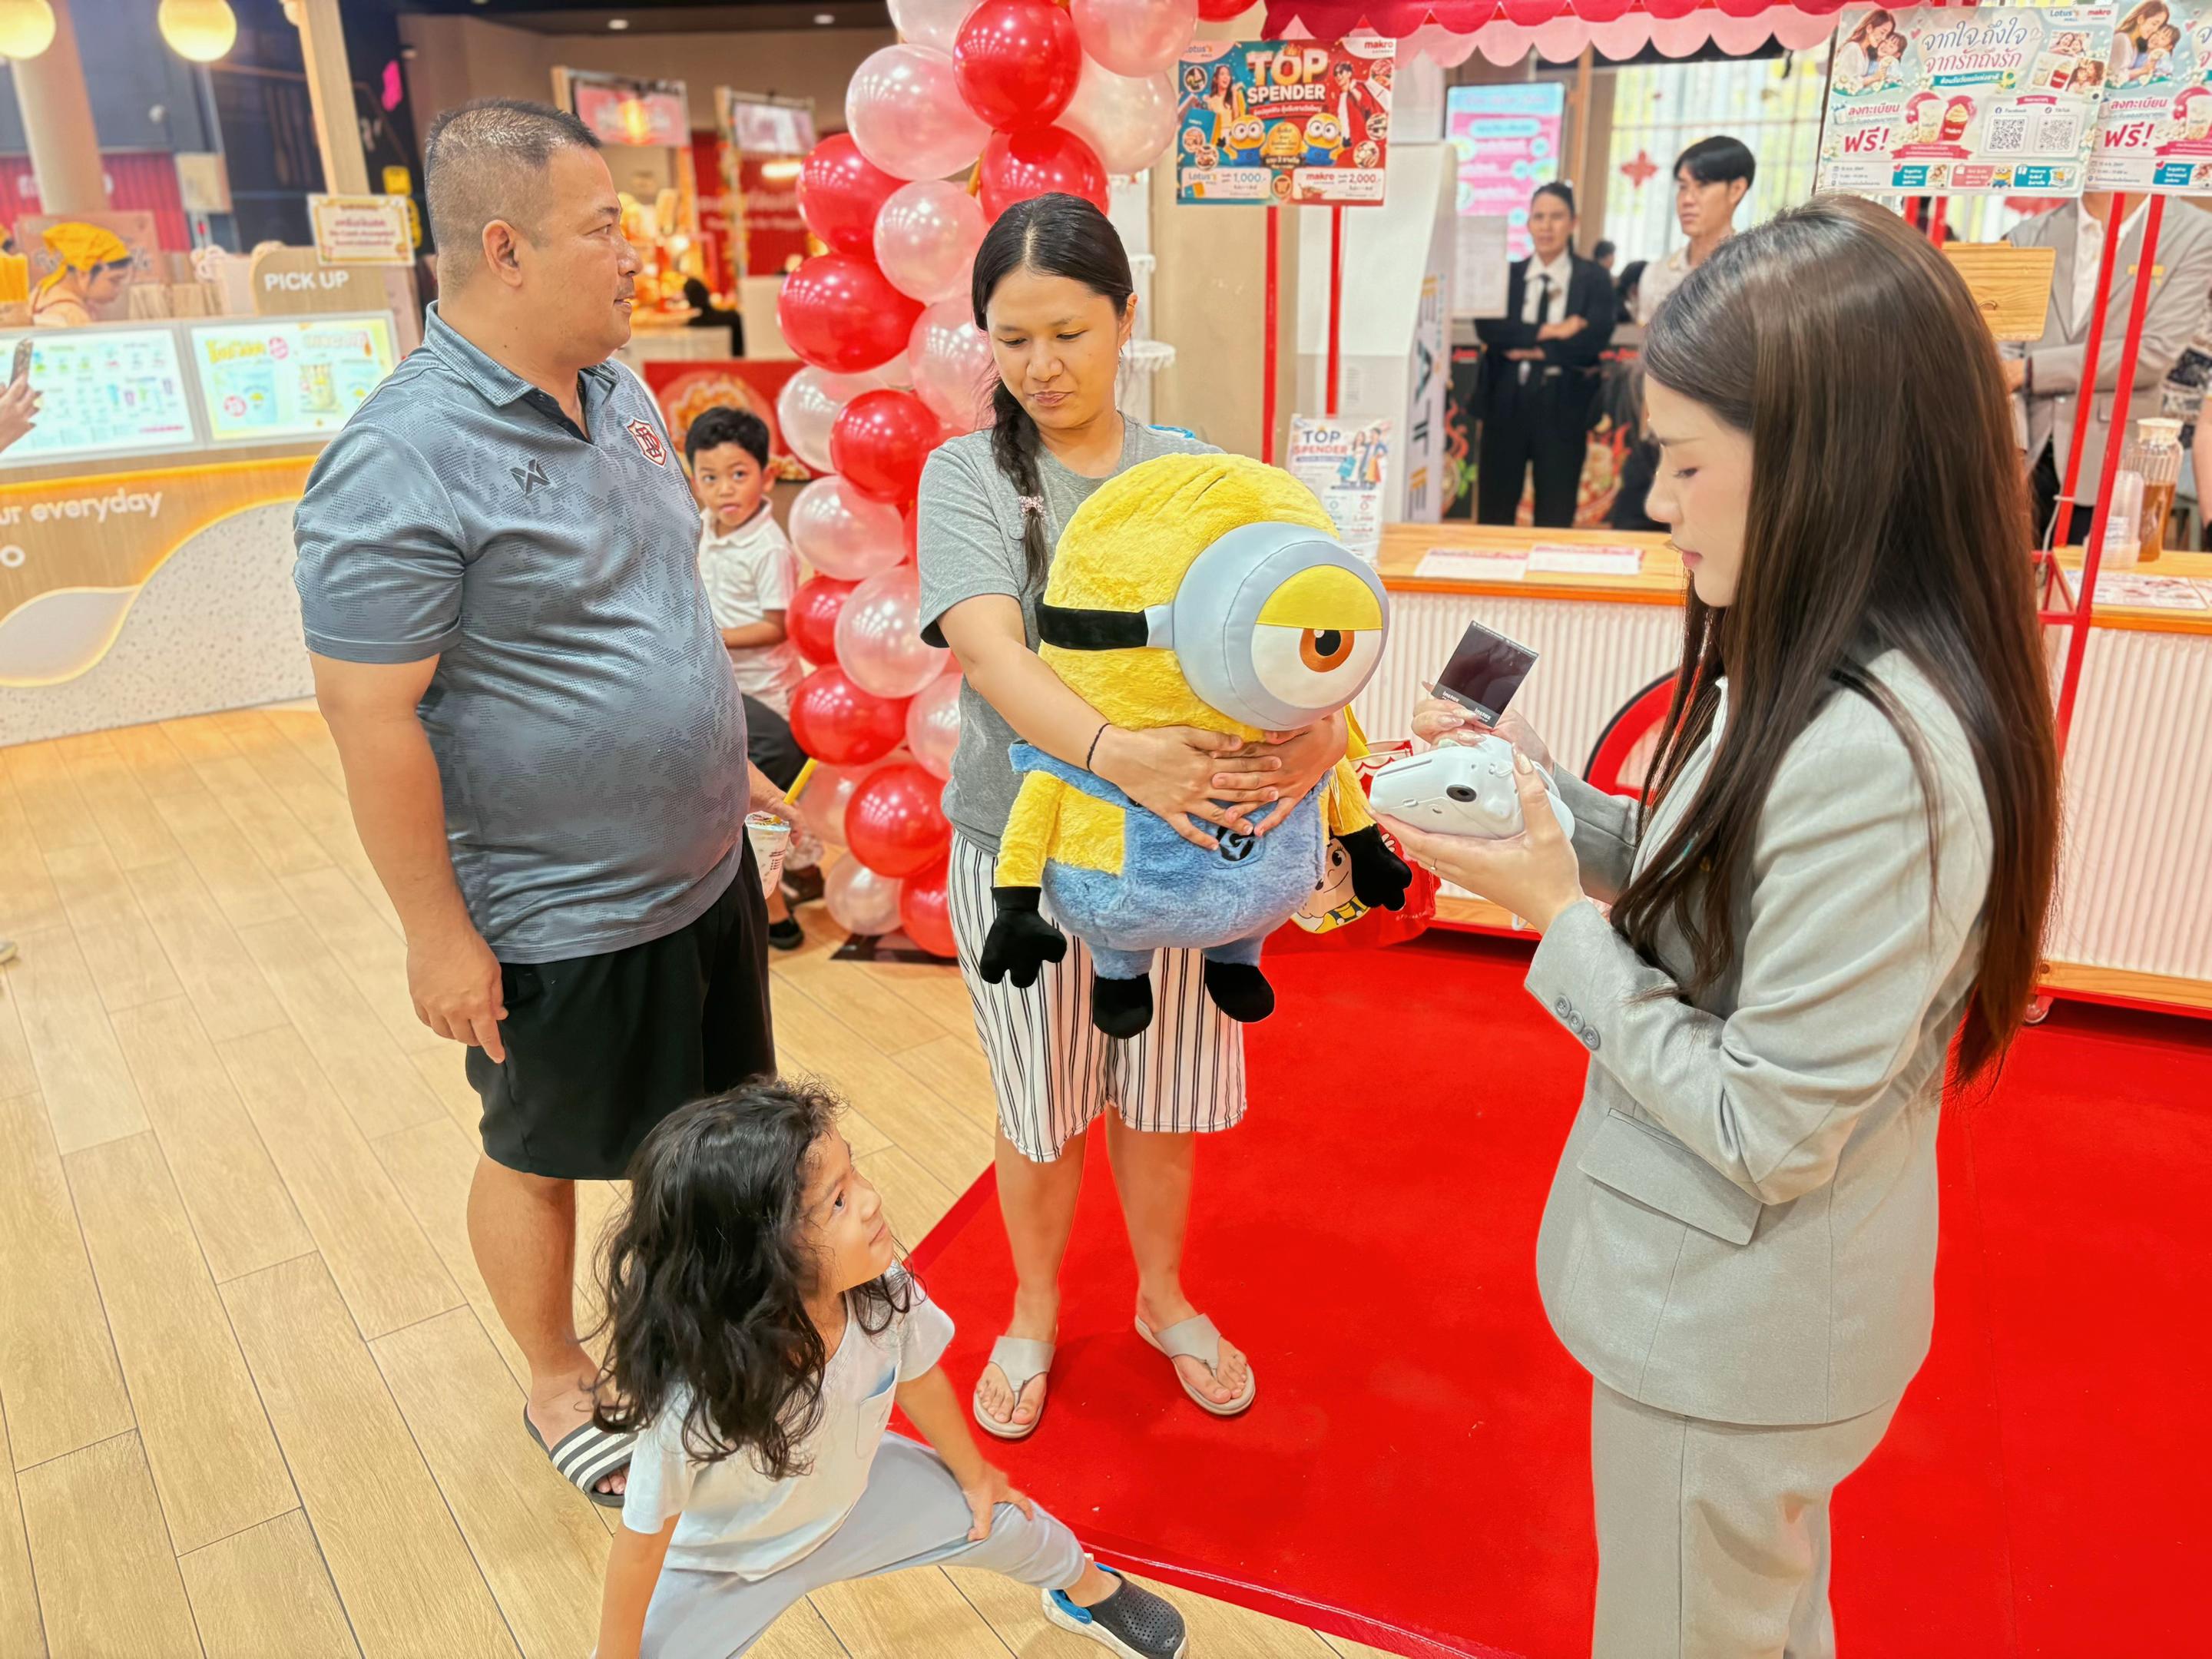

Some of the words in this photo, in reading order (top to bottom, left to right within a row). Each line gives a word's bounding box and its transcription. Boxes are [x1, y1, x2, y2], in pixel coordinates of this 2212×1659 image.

[1364, 40, 1393, 49] makro
[1246, 48, 1329, 88] TOP
[1247, 84, 1326, 104] SPENDER
[1847, 103, 1901, 116] ลงทะเบียน
[1845, 126, 1889, 153] ฟรี!
[2104, 121, 2155, 148] ฟรี!
[1306, 171, 1335, 180] makro
[264, 271, 316, 291] PICK
[320, 270, 349, 289] UP
[1303, 430, 1341, 444] TOP
[1293, 445, 1348, 455] SPENDER
[30, 486, 163, 524] everyday
